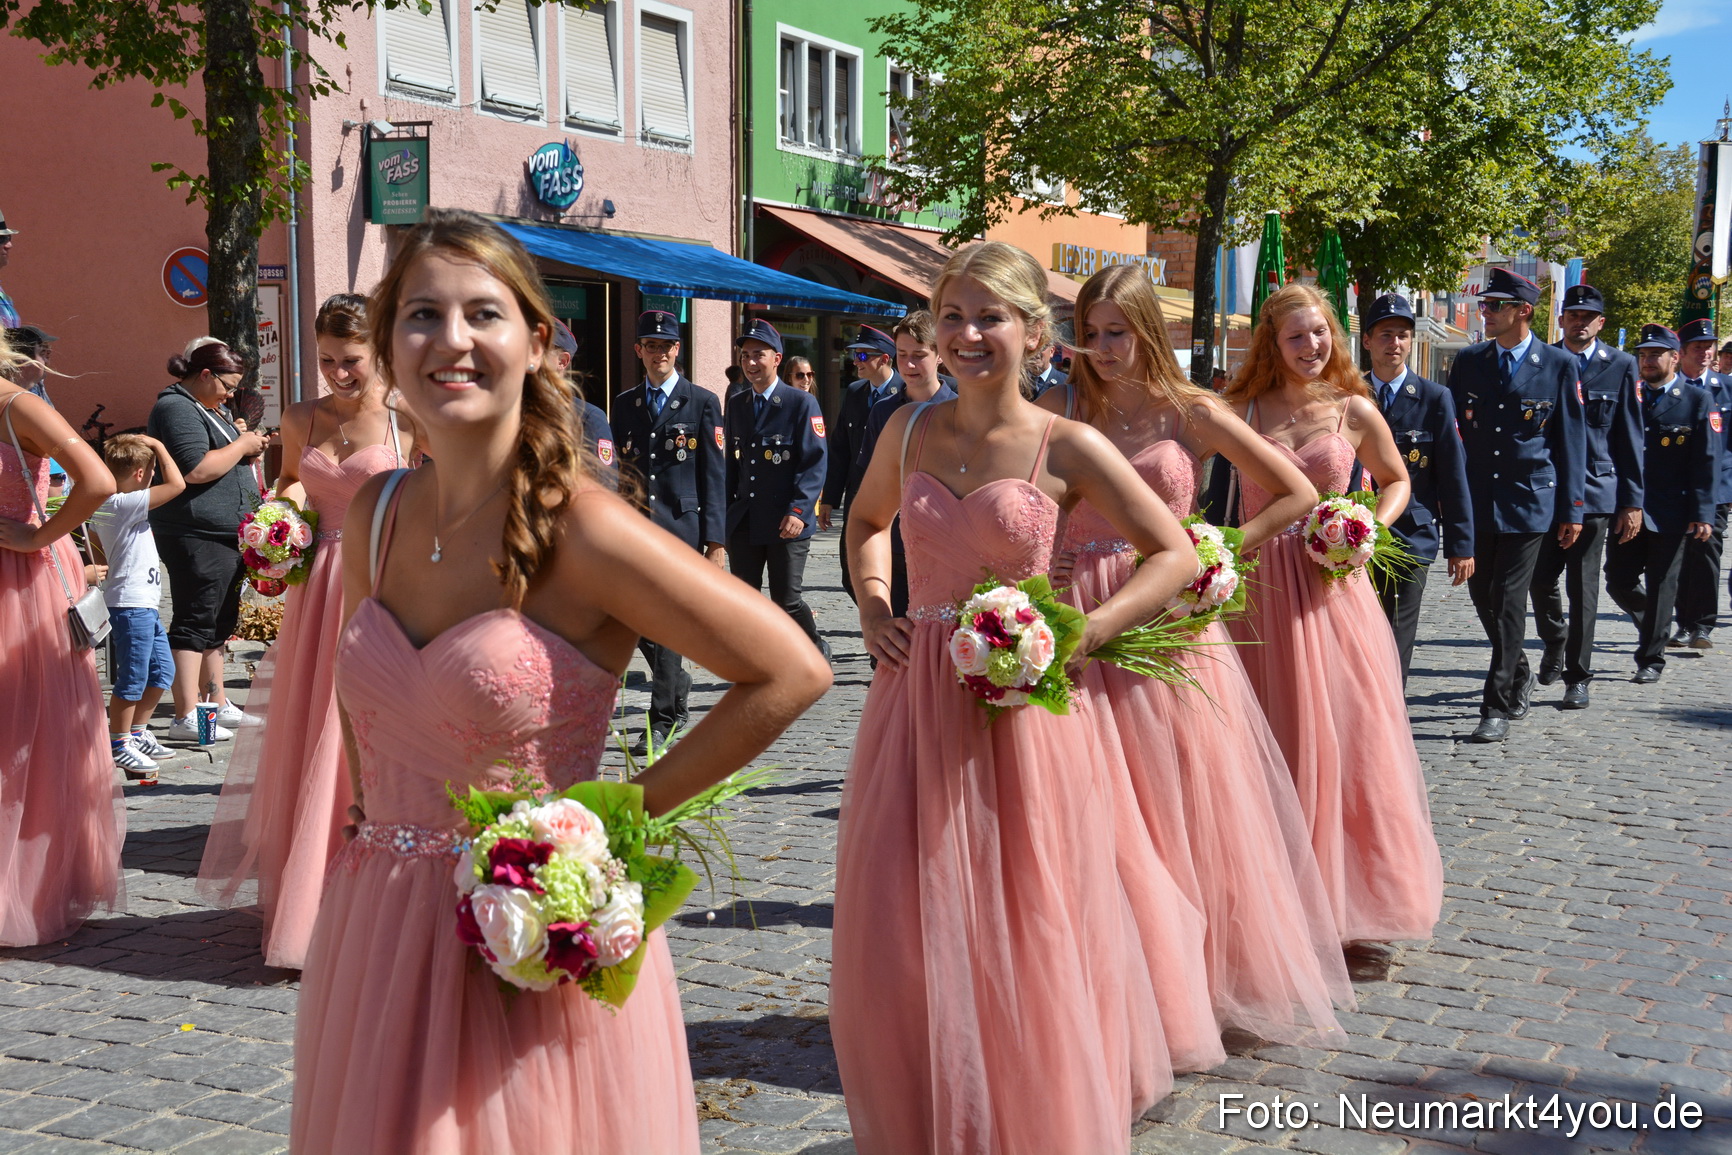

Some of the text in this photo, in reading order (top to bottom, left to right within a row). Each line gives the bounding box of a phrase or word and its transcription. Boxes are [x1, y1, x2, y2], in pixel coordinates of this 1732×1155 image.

[378, 154, 401, 171] vom
[386, 157, 420, 183] FASS
[528, 148, 559, 174] vom
[538, 164, 583, 200] FASS
[382, 207, 417, 215] GENIESSEN
[1059, 243, 1097, 276] LEDER
